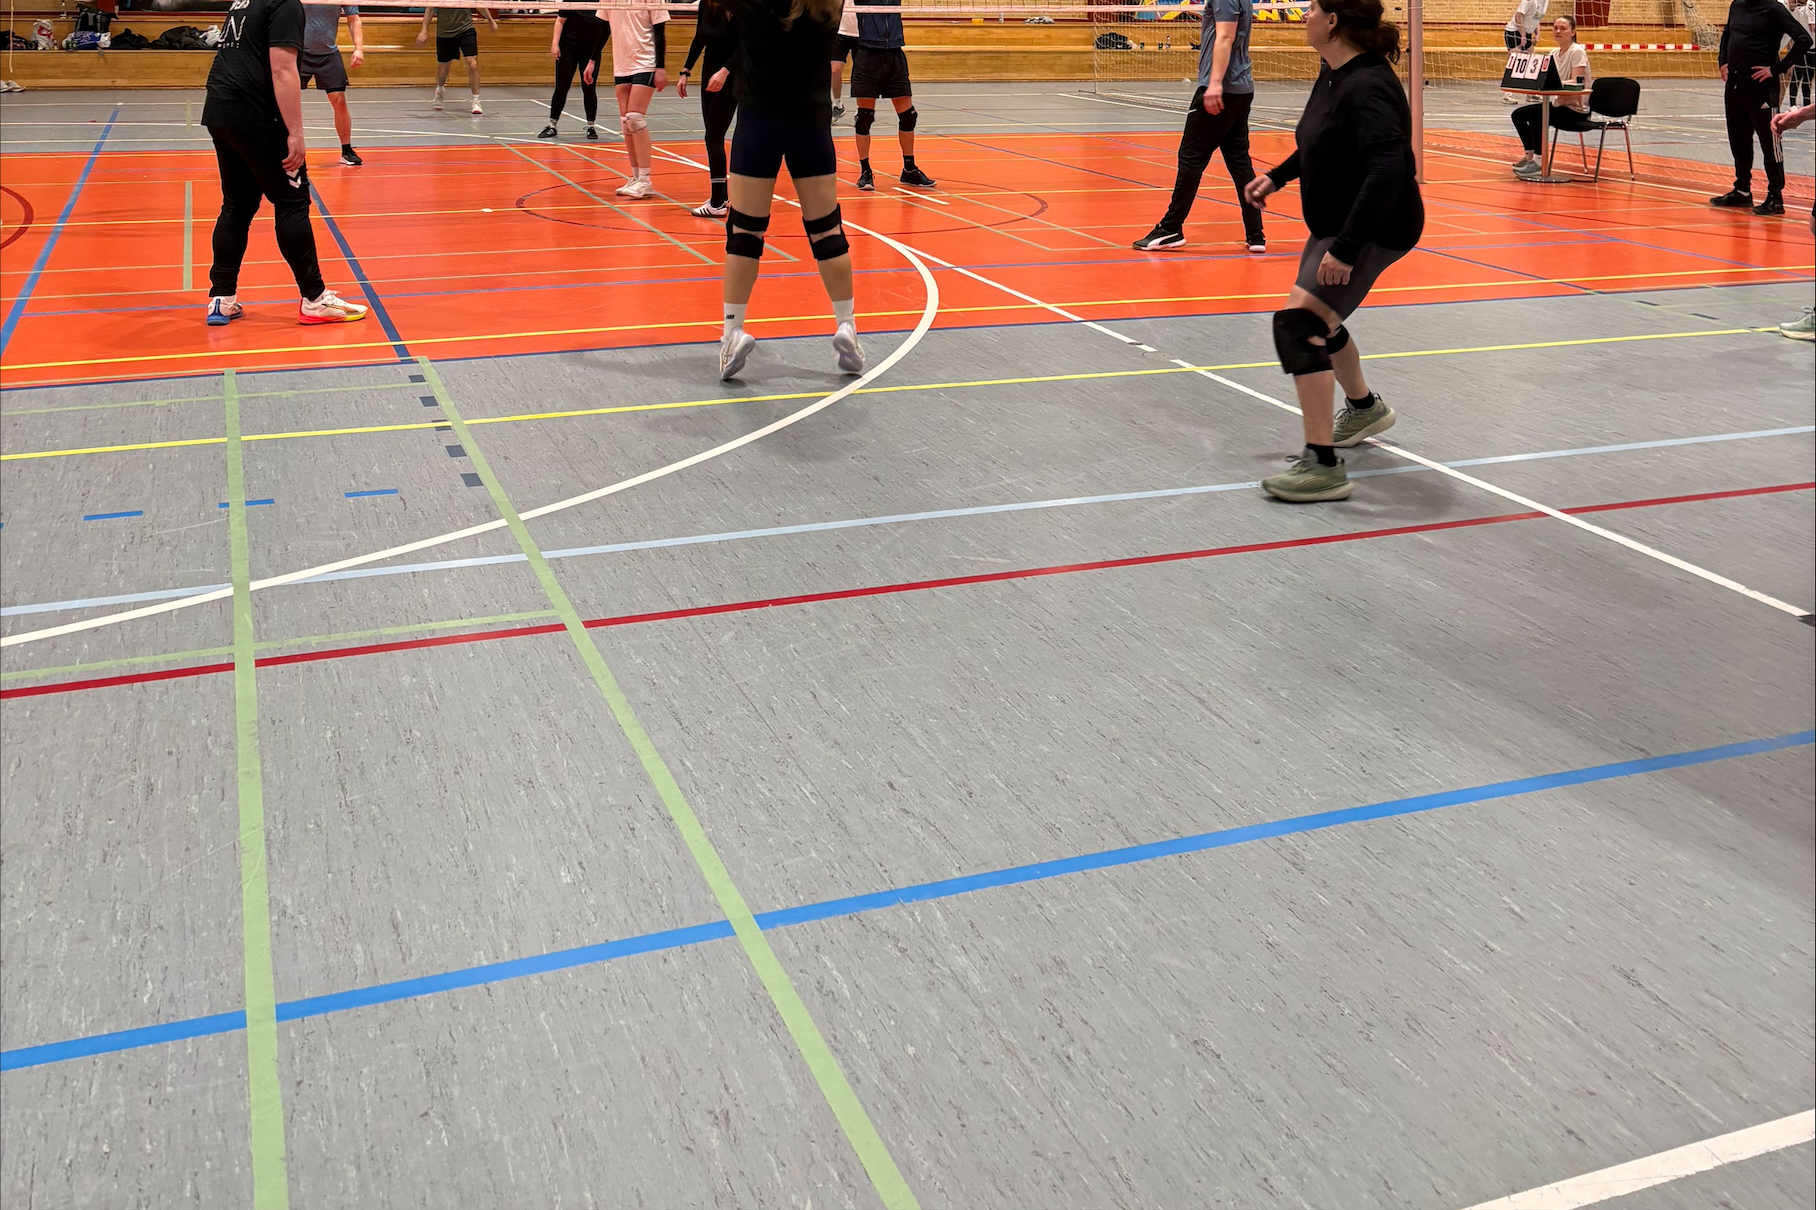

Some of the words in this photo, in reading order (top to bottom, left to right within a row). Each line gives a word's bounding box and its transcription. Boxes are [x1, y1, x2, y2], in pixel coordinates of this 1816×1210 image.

[1515, 58, 1528, 73] 10
[1530, 59, 1539, 73] 3
[1542, 58, 1549, 70] 0
